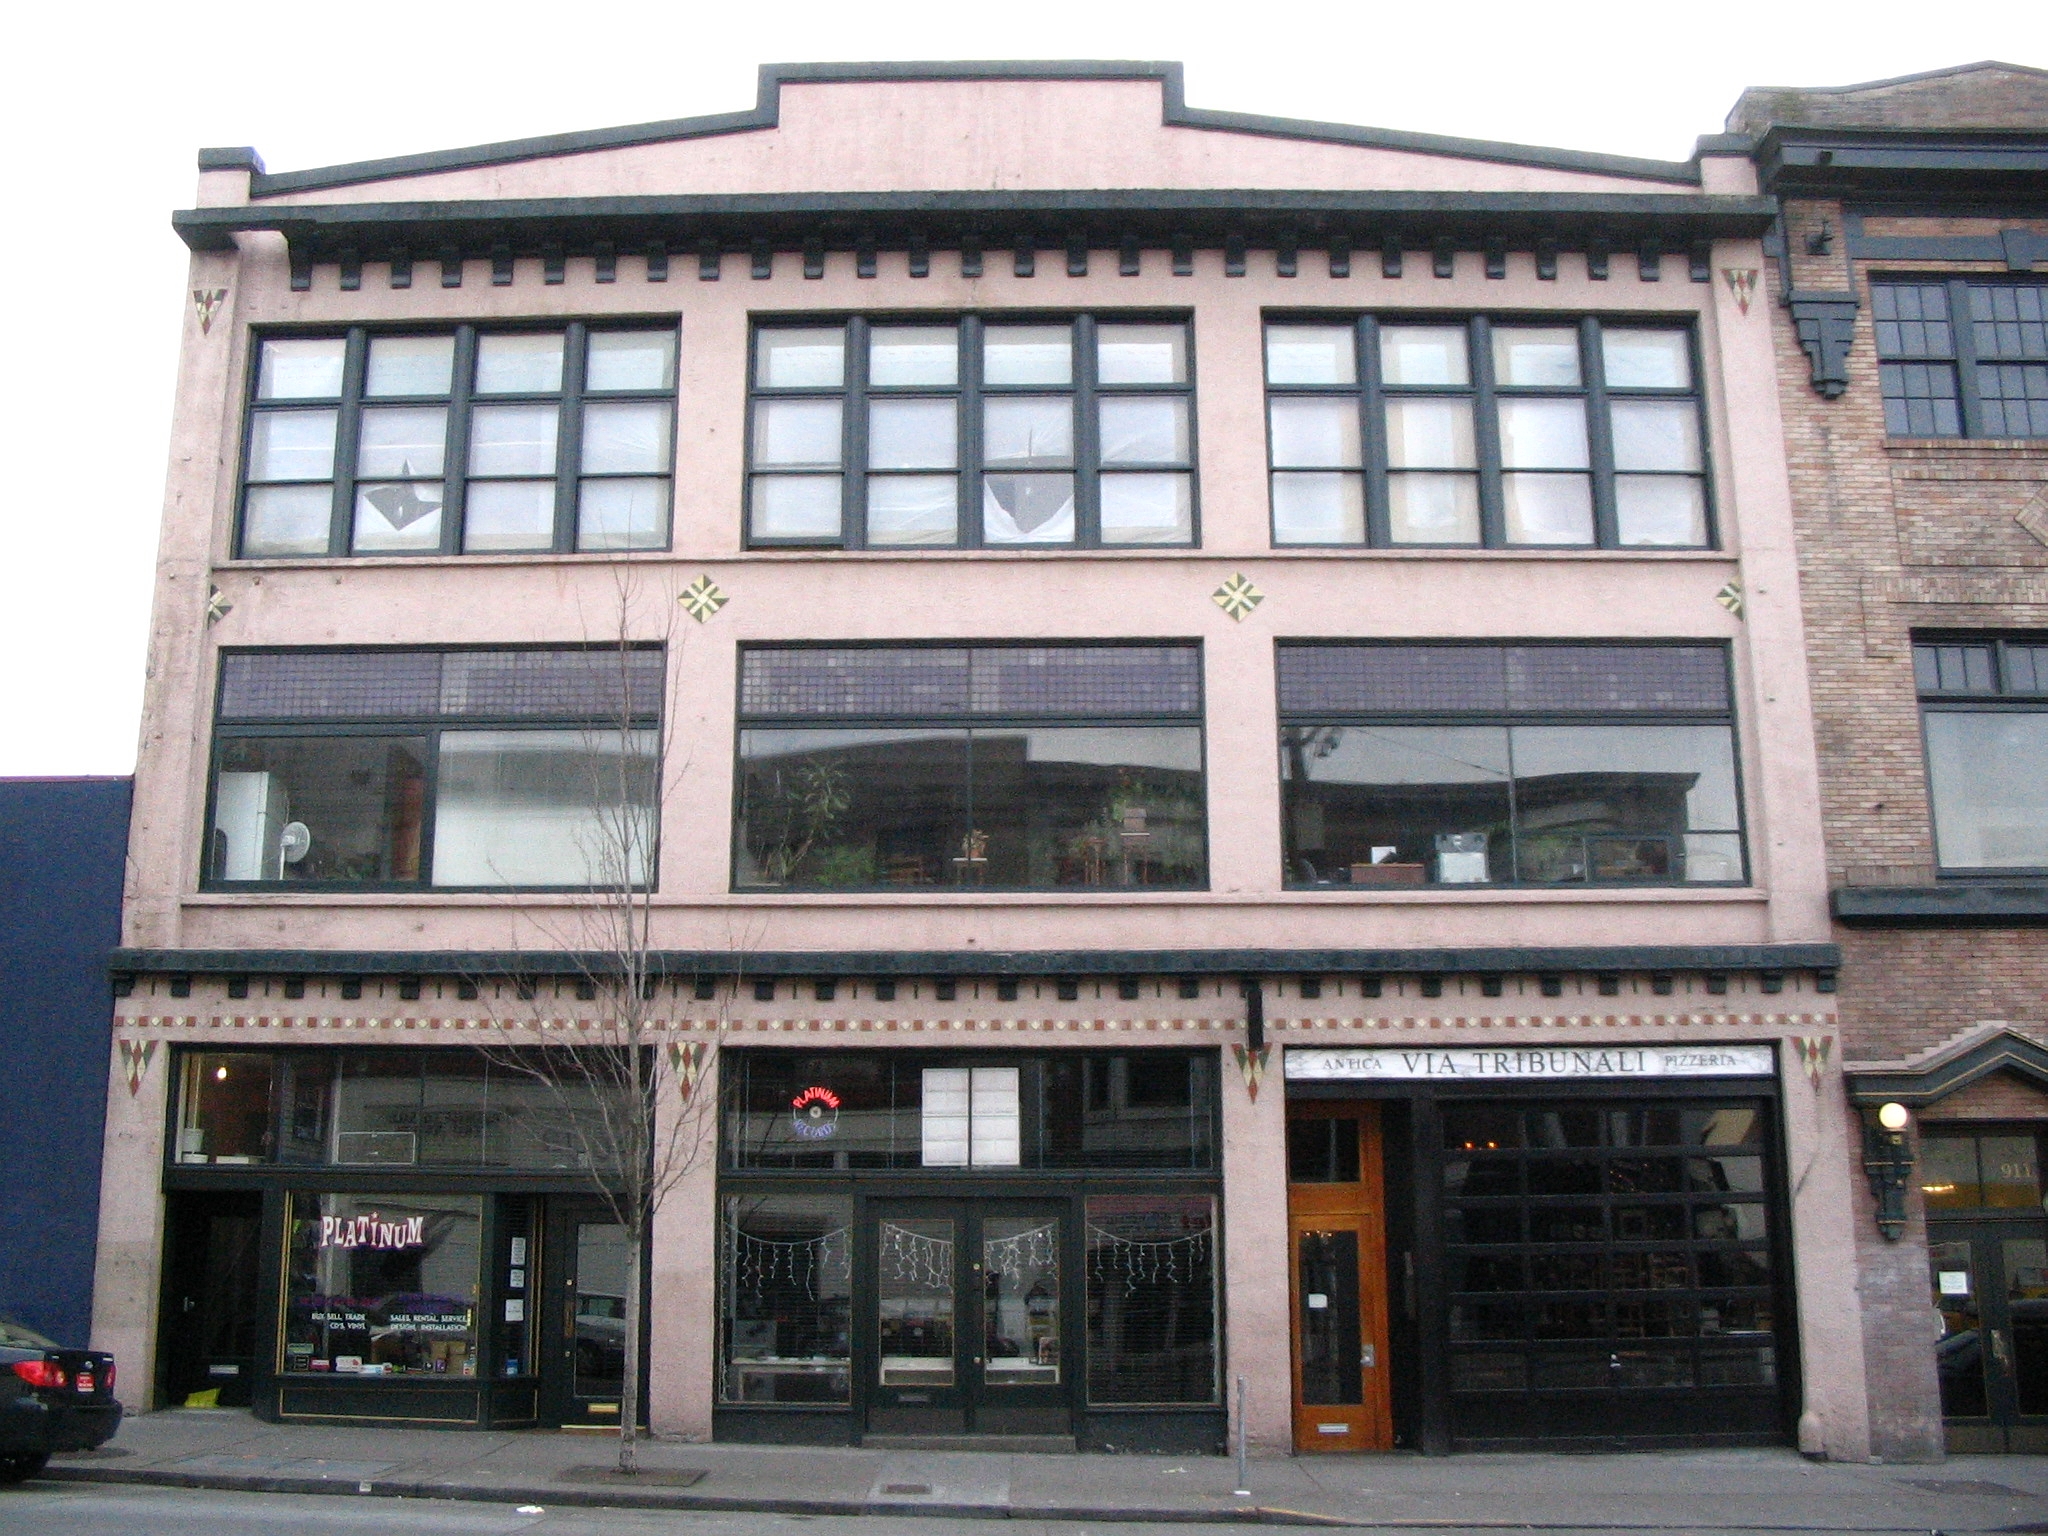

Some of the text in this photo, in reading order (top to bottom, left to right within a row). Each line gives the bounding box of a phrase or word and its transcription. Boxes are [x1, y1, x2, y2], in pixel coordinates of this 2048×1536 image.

[1322, 1050, 1738, 1075] ANTICA VIA TRIBUNALI PIZZERIA
[792, 1086, 840, 1109] PLATINUM
[2001, 1163, 2032, 1179] 911
